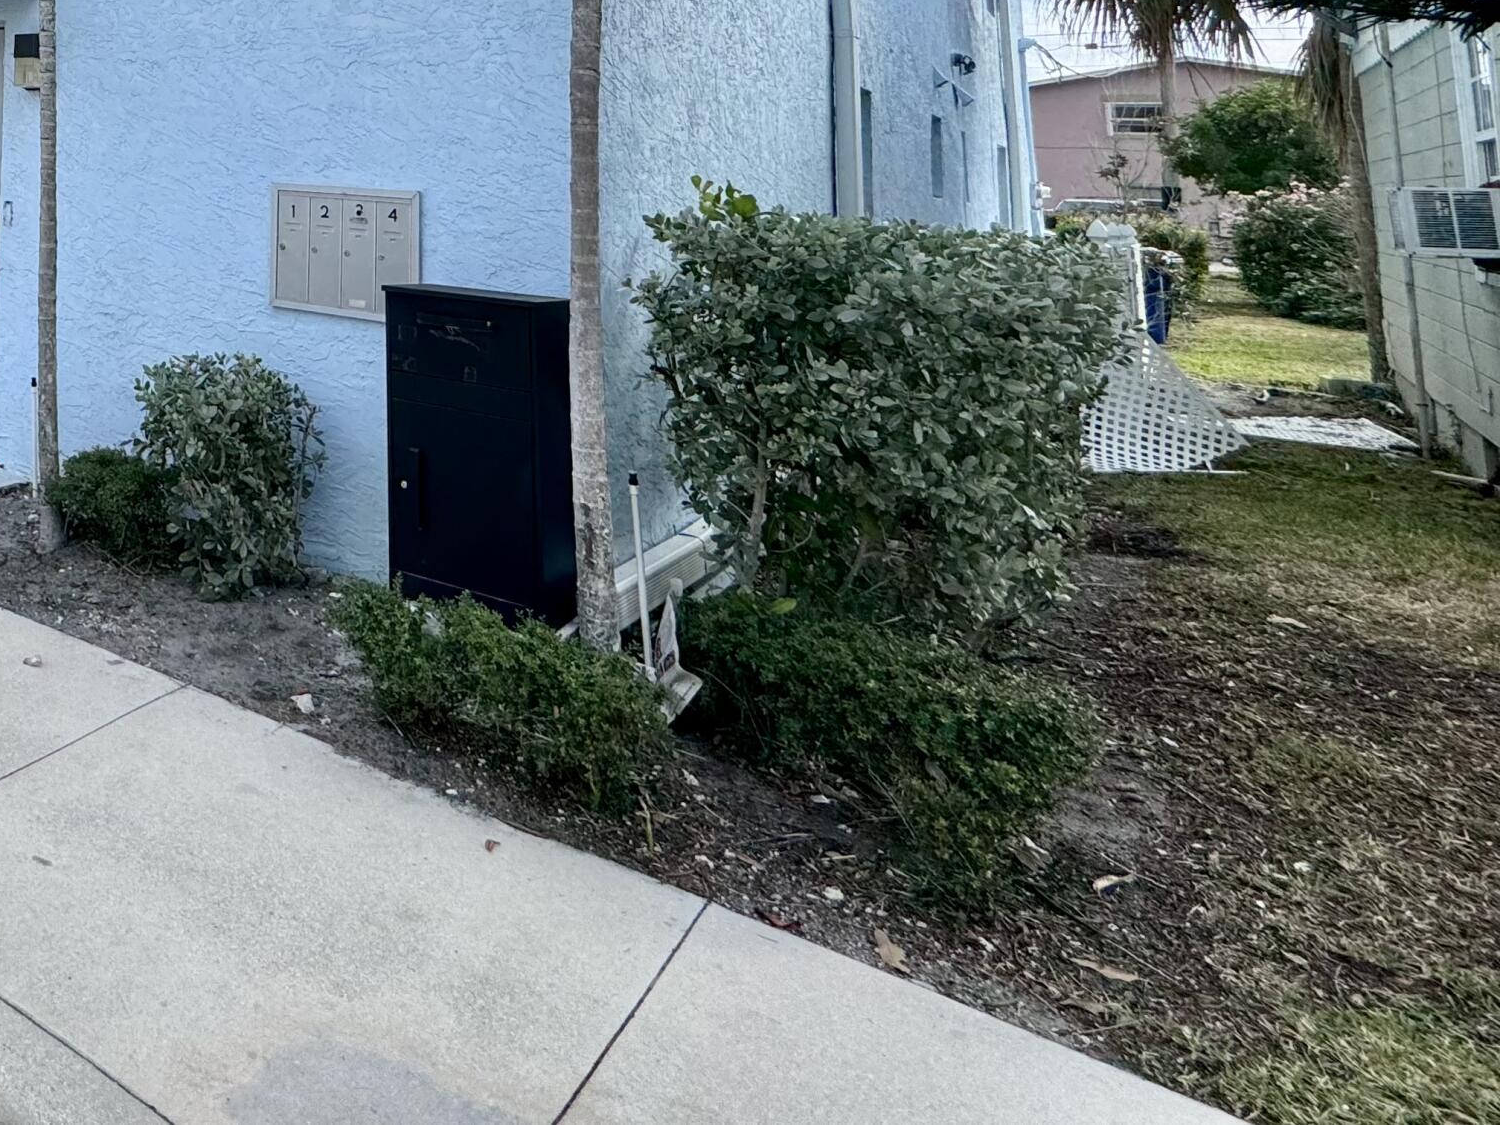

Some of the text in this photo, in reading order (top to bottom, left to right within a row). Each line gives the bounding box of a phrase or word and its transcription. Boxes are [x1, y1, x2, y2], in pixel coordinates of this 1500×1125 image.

[291, 204, 296, 218] 1
[320, 205, 329, 219] 2
[387, 208, 398, 223] 4
